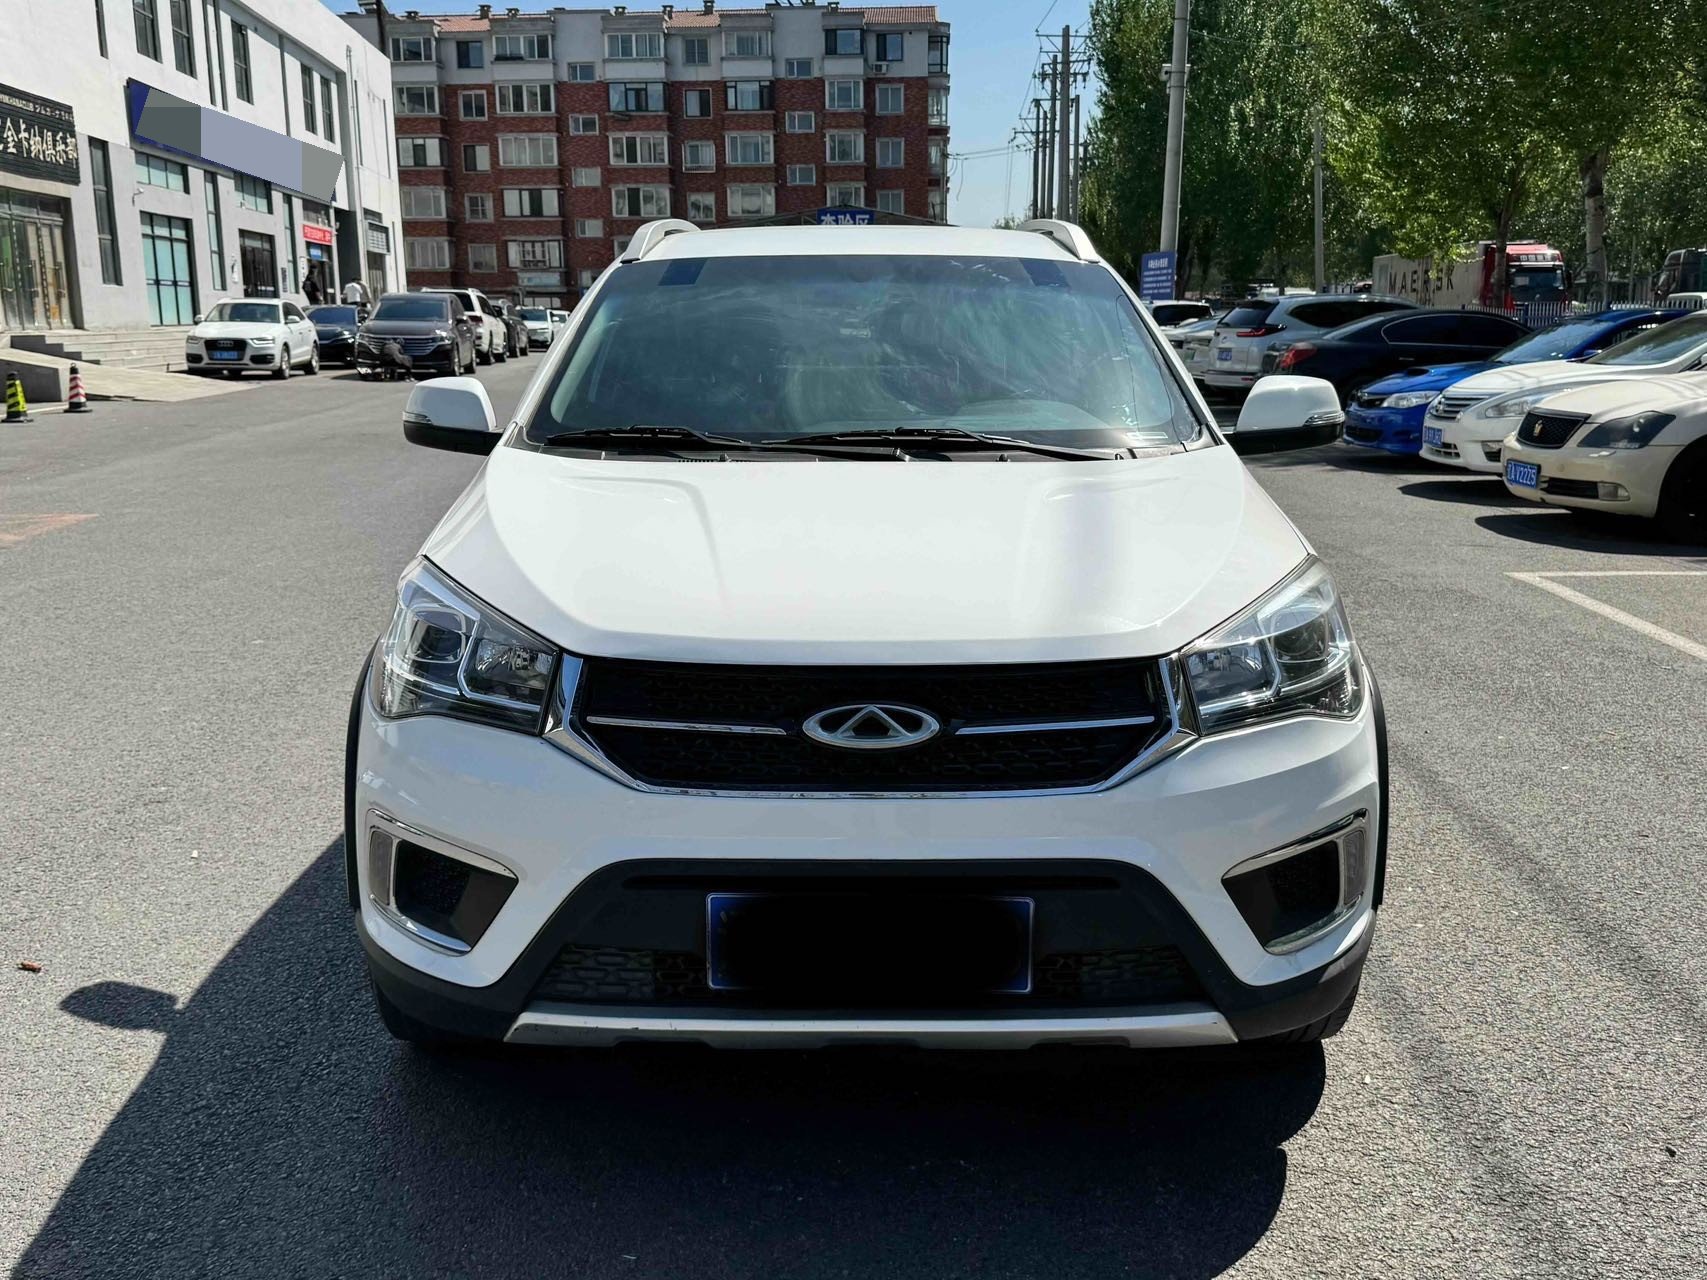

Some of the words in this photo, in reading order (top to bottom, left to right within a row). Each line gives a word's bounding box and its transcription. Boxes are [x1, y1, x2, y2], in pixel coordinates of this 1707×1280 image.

[0, 117, 78, 168] 金卡纳俱乐部
